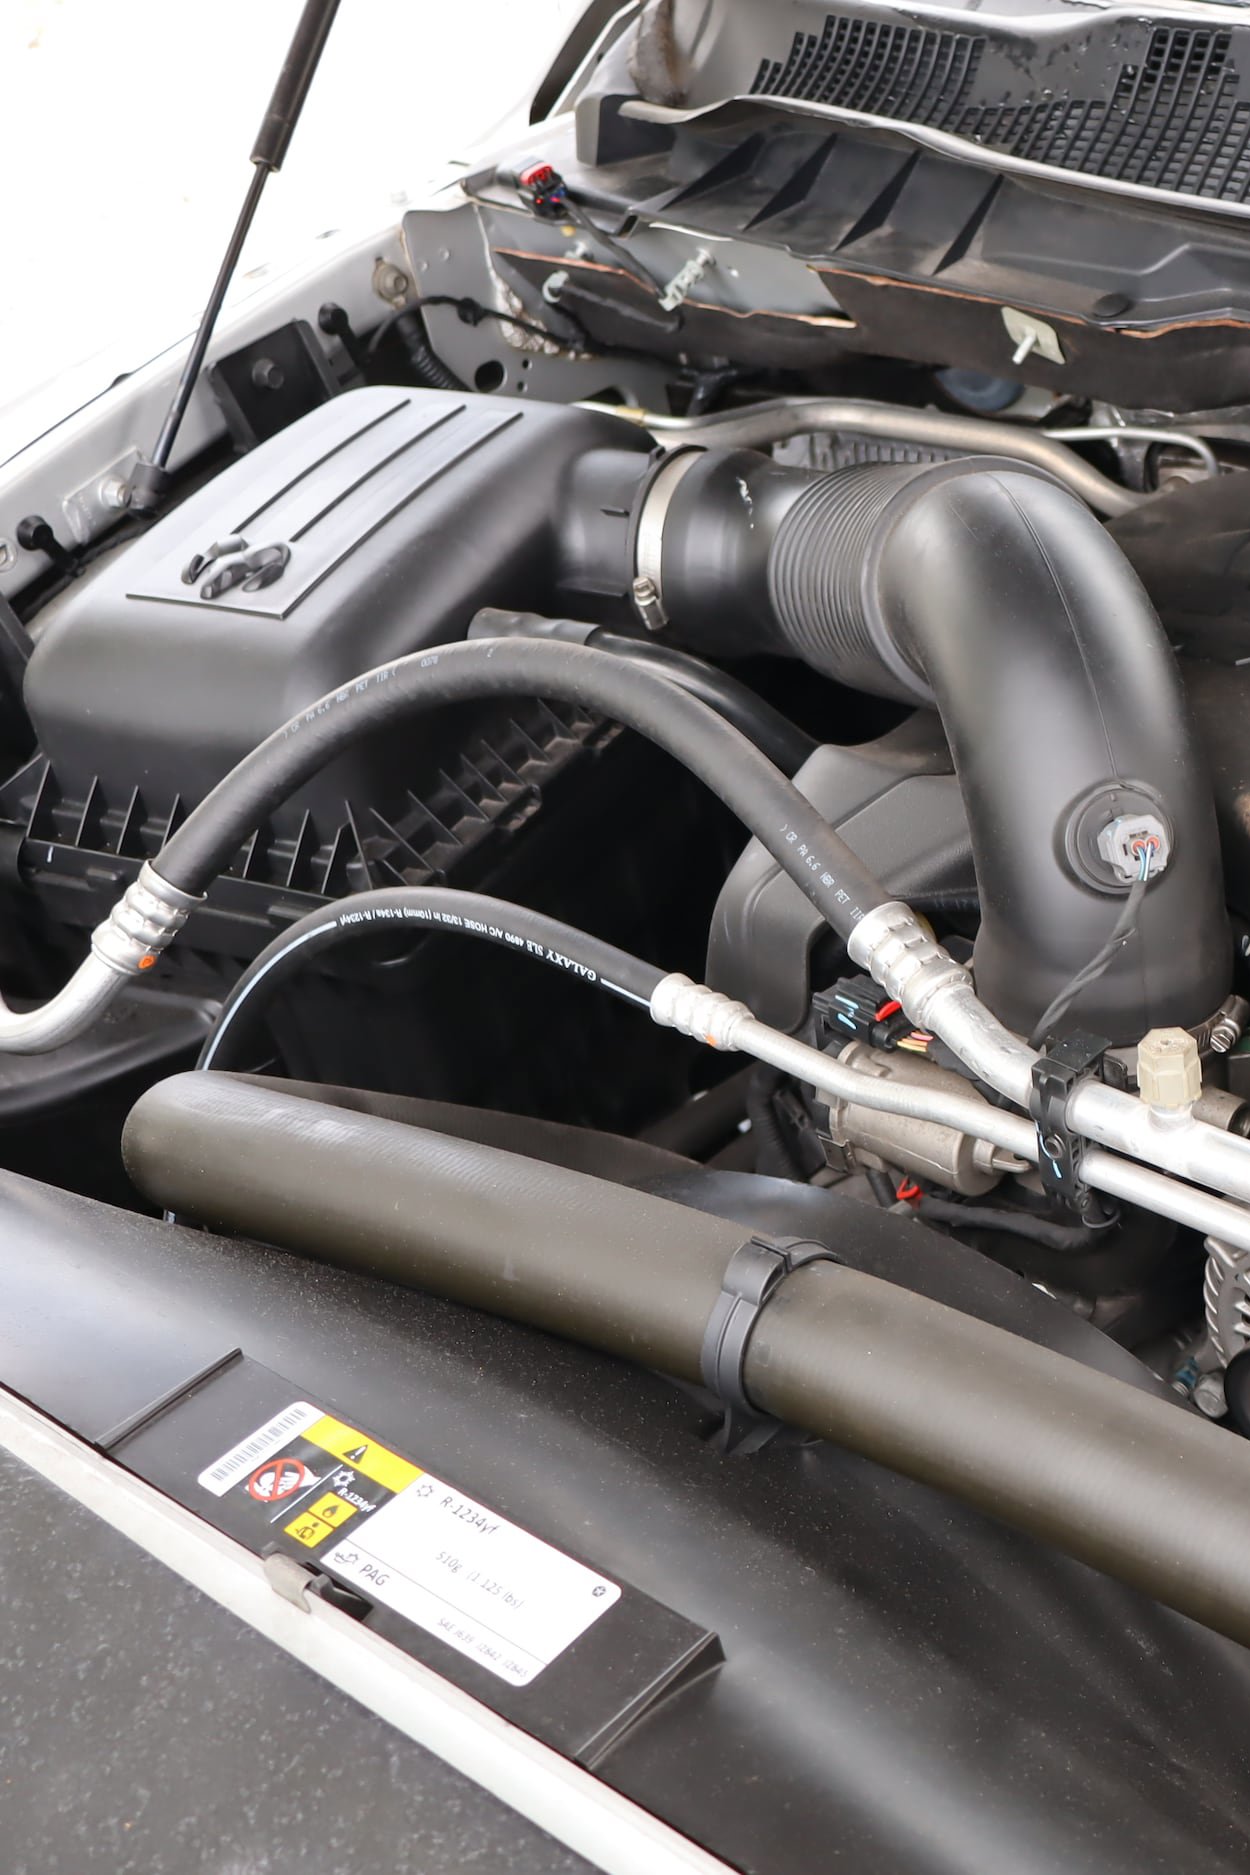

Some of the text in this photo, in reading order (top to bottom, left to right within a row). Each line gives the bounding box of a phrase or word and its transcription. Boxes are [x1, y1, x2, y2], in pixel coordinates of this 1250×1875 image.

[402, 905, 433, 924] (10mm)
[463, 917, 488, 935] HOSE
[488, 924, 504, 939] A/C
[545, 948, 598, 982] GALAXY
[337, 1487, 377, 1513] R-1234yf
[439, 1495, 500, 1535] R-1234yf
[359, 1562, 390, 1588] PAG
